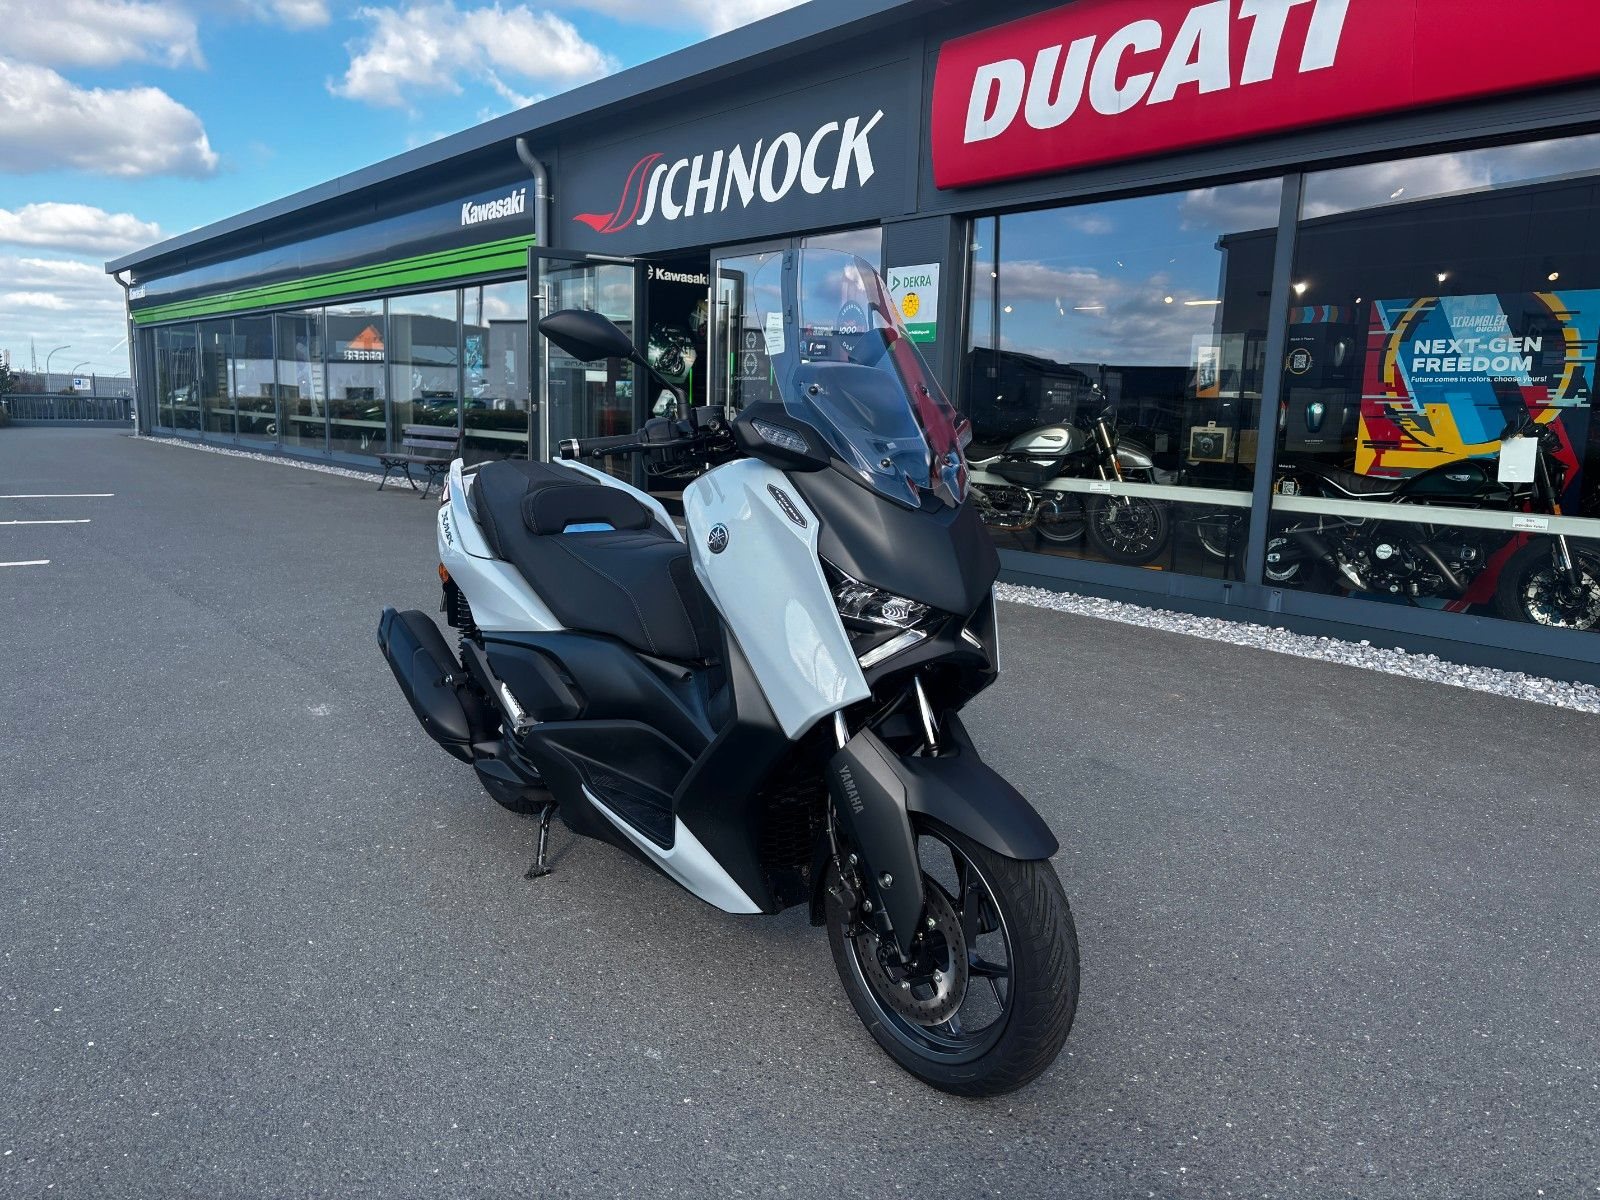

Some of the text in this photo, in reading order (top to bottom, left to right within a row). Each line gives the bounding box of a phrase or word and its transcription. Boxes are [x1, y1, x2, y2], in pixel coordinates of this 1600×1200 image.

[963, 0, 1351, 144] DUCATI
[636, 109, 884, 226] SCHNOCK
[461, 187, 526, 226] Kawasaki
[655, 267, 710, 285] Kawasaki
[903, 274, 932, 288] DEKRA
[1450, 314, 1508, 328] SCRAMBLER
[1413, 336, 1543, 355] NEXT-GEN
[1411, 355, 1533, 373] FREEDOM
[1459, 375, 1467, 383] in
[1493, 375, 1521, 383] choose
[1522, 375, 1548, 384] yours!
[839, 764, 865, 814] YAMAHA
